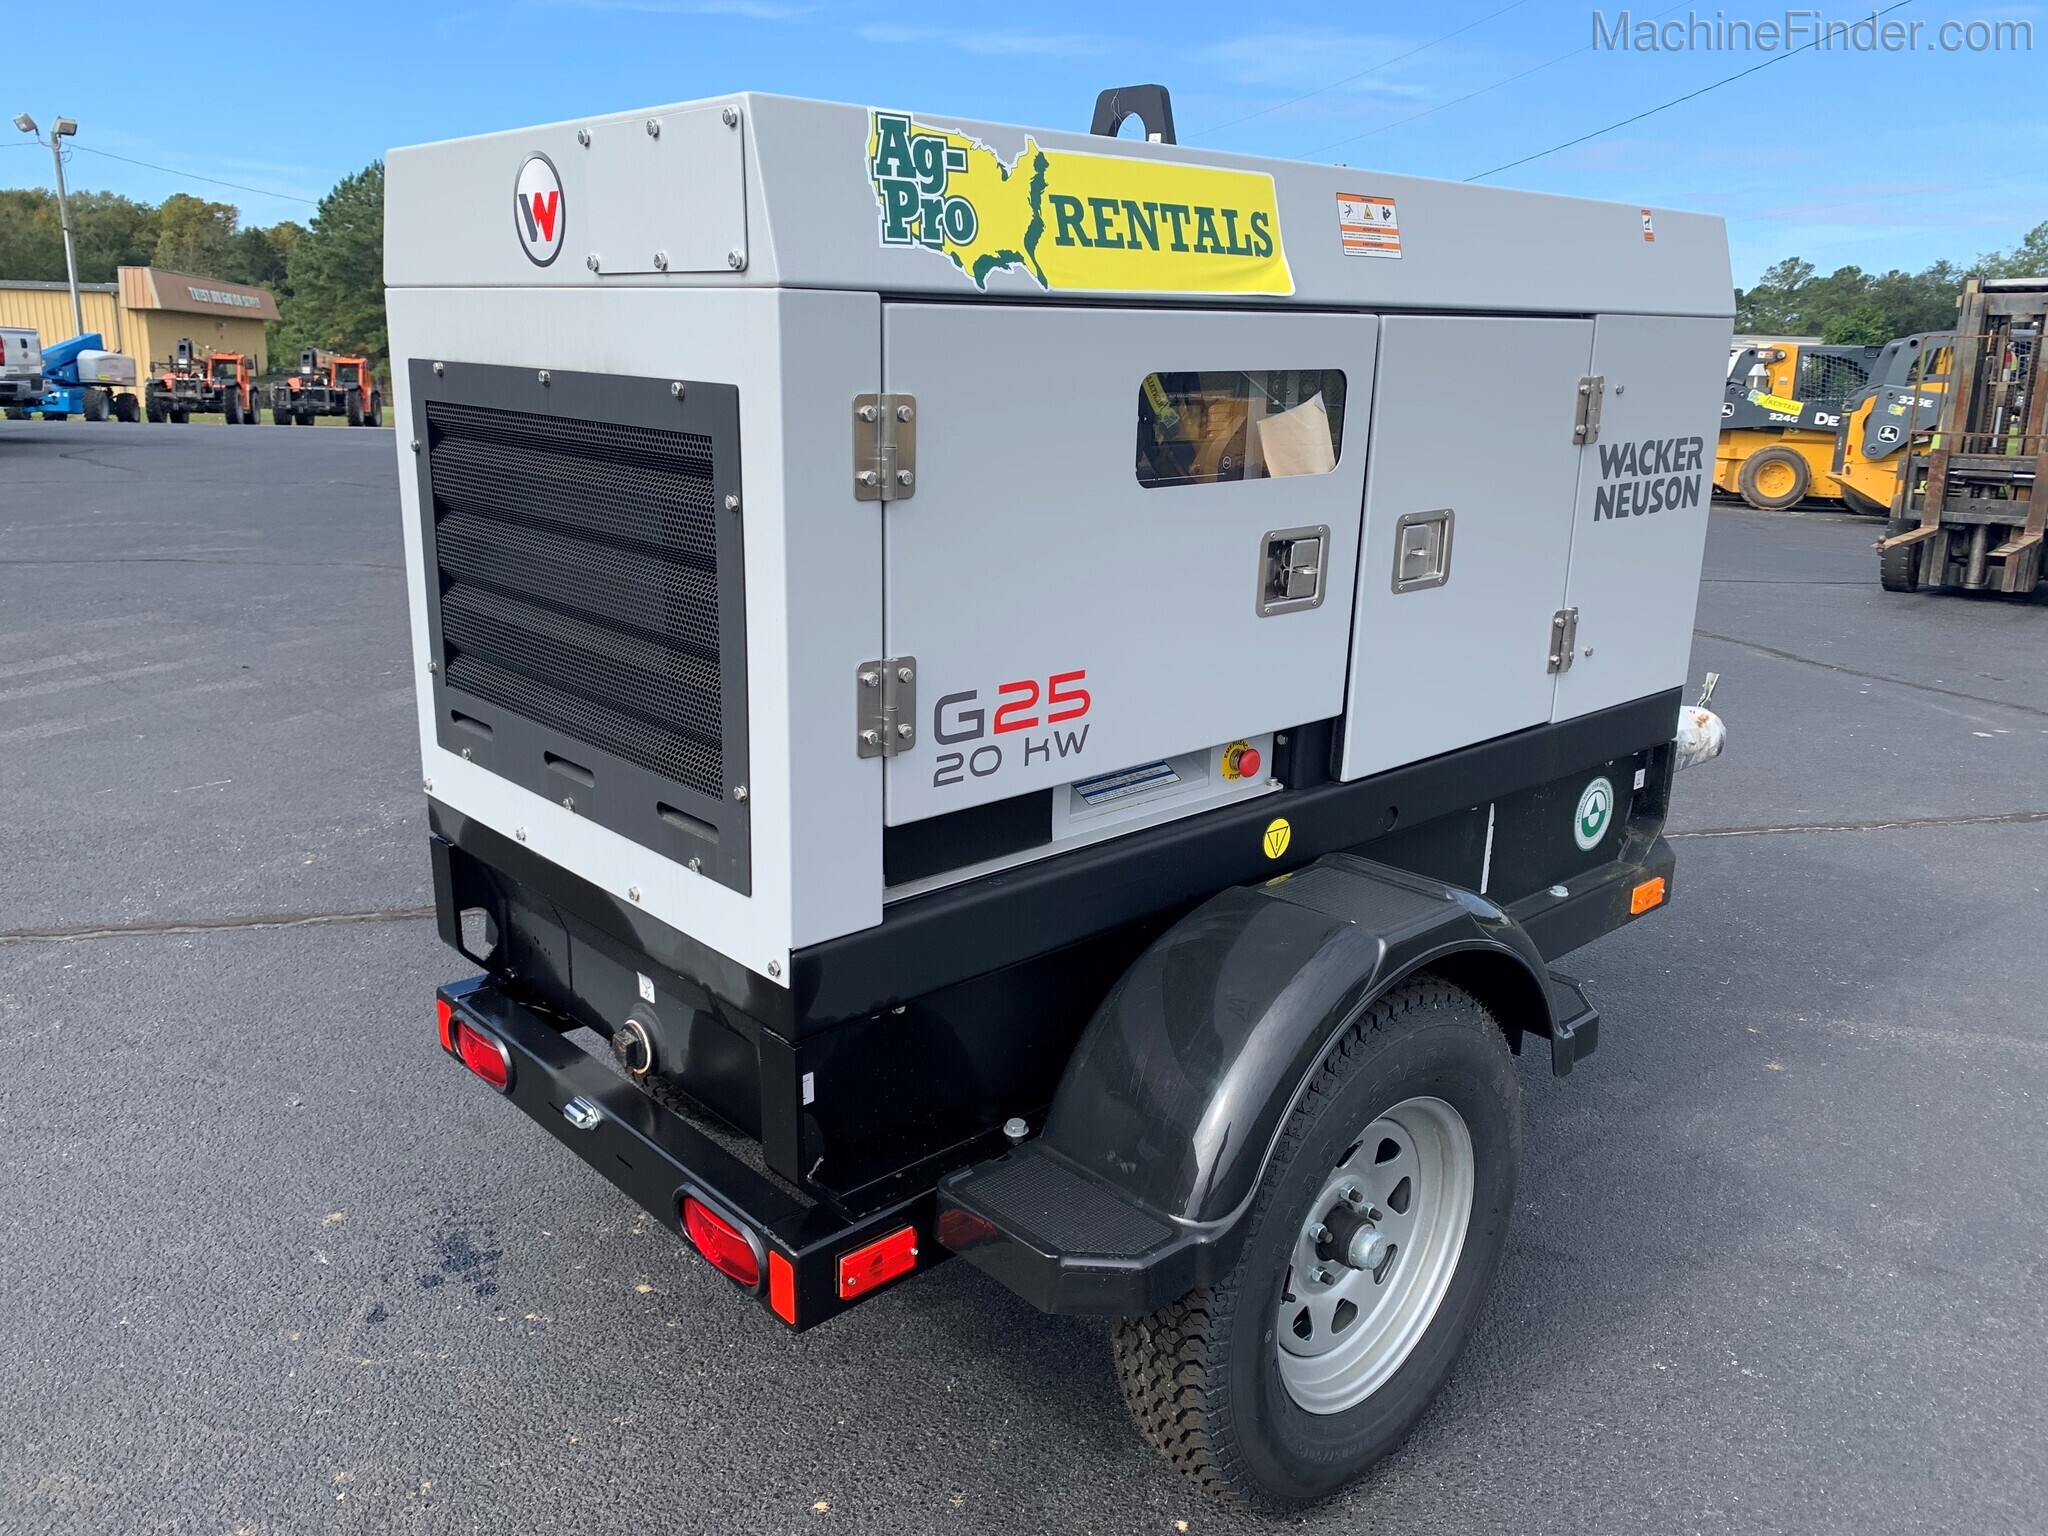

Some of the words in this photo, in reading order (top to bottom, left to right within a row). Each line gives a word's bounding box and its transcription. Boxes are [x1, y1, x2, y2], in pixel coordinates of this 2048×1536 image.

[875, 113, 967, 194] Ag-
[881, 179, 977, 245] Pro
[1049, 194, 1273, 258] RENTALS
[1767, 400, 1800, 412] RENTALS
[1769, 412, 1799, 423] 324G
[1599, 436, 1704, 480] WACKER
[1594, 474, 1702, 522] NEUSON
[934, 669, 1091, 745] G25
[933, 745, 1003, 788] 20
[1224, 740, 1249, 759] EMERGENC
